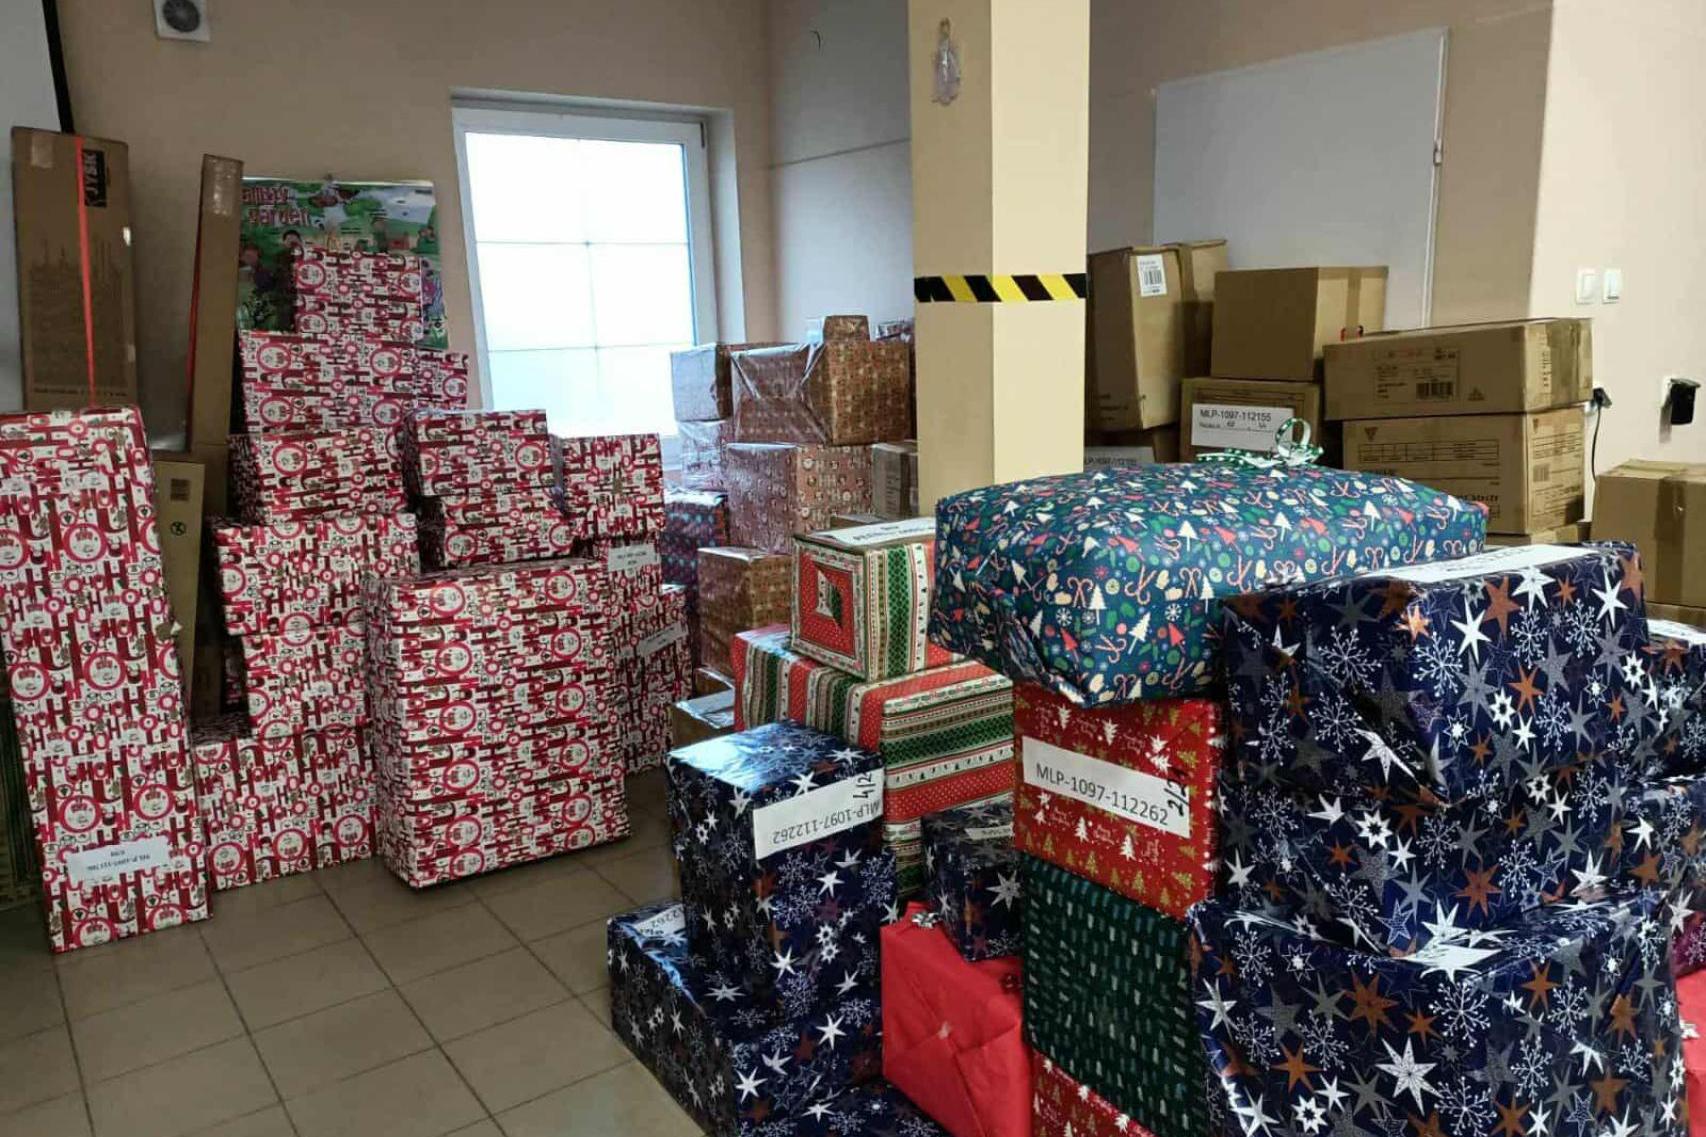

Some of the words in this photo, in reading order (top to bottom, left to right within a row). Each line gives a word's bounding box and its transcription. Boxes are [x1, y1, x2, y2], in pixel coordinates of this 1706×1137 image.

[84, 150, 99, 196] JYSK
[1036, 763, 1168, 826] MLP-1097-112262
[772, 799, 881, 844] MLP-1097-112262
